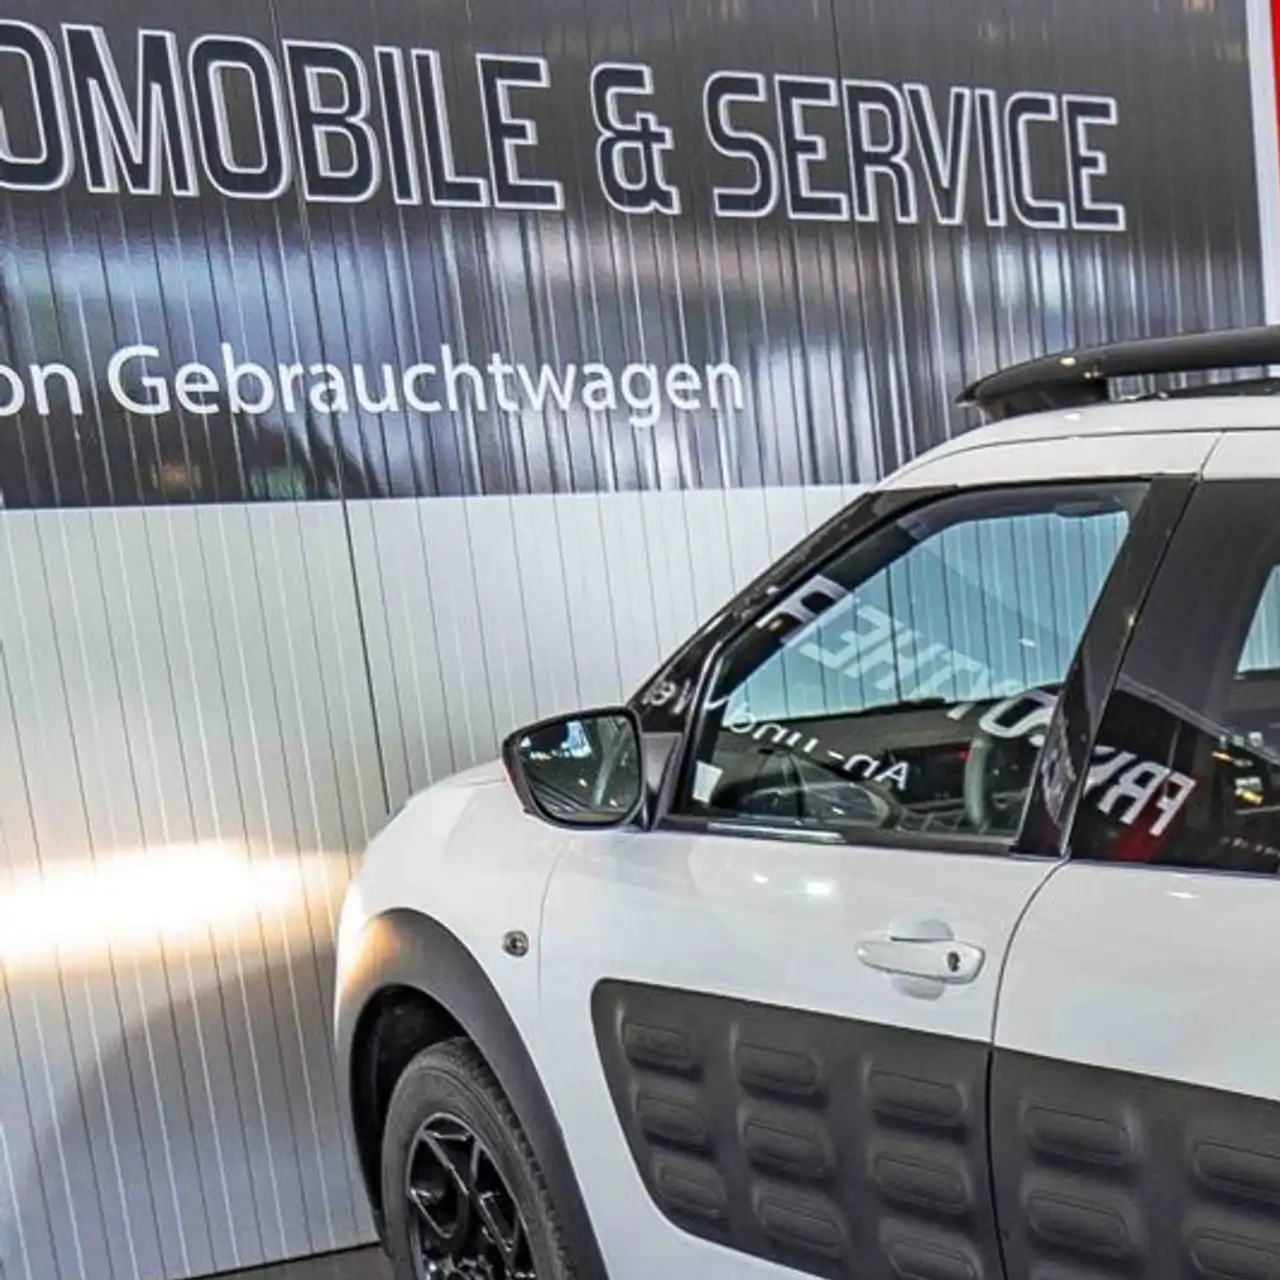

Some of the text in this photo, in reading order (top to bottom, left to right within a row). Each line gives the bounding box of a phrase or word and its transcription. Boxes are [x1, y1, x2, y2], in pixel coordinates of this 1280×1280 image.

[0, 18, 1126, 232] OMOBILE & SERVICE
[106, 342, 745, 428] Gebrauchtwagen
